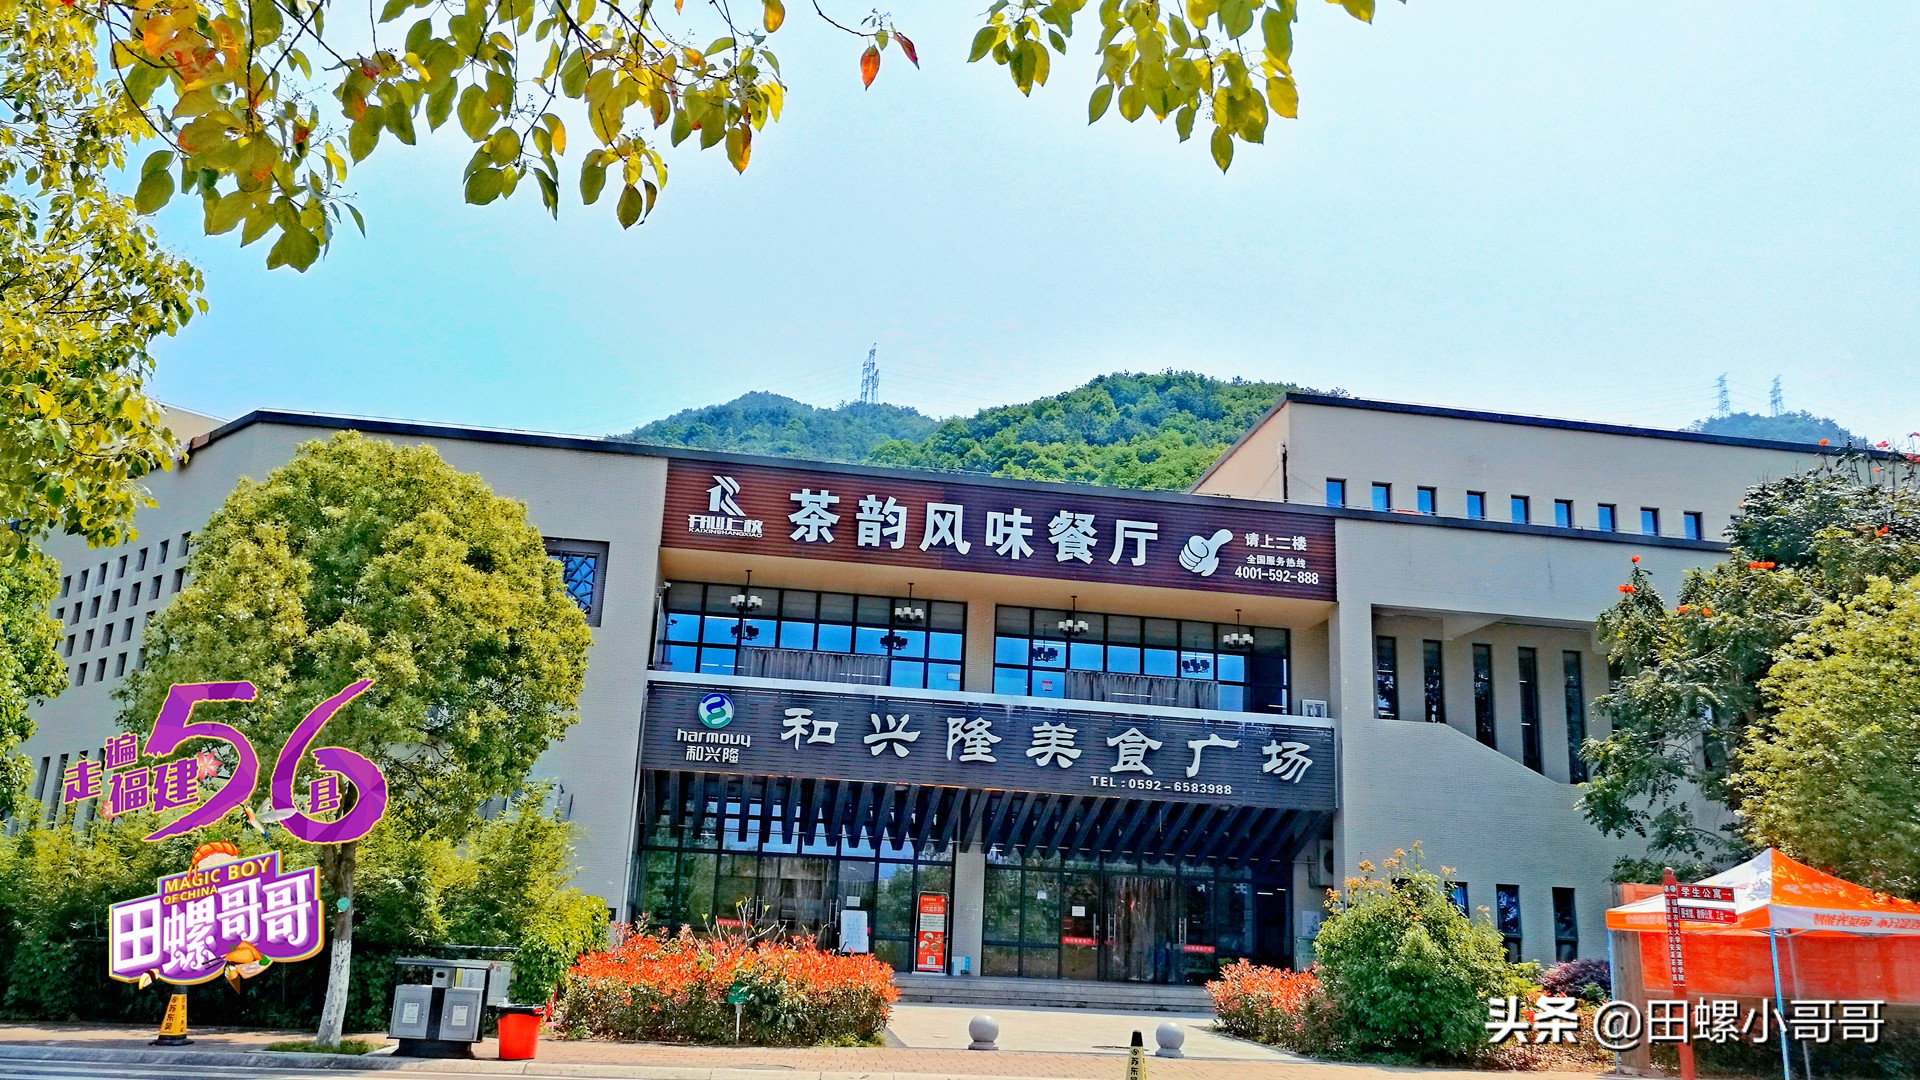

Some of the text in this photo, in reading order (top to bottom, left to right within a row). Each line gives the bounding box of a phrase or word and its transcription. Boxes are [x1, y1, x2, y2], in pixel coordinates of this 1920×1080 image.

[787, 488, 1159, 567] 茶韵风味餐厅
[1245, 532, 1307, 551] 请上二楼
[1246, 554, 1306, 569] 全国服务热线
[1235, 565, 1319, 585] 4001-592-888
[686, 745, 740, 764] 和兴隆
[780, 707, 1314, 784] 和兴隆美食广场
[1681, 886, 1722, 899] 学生公寓
